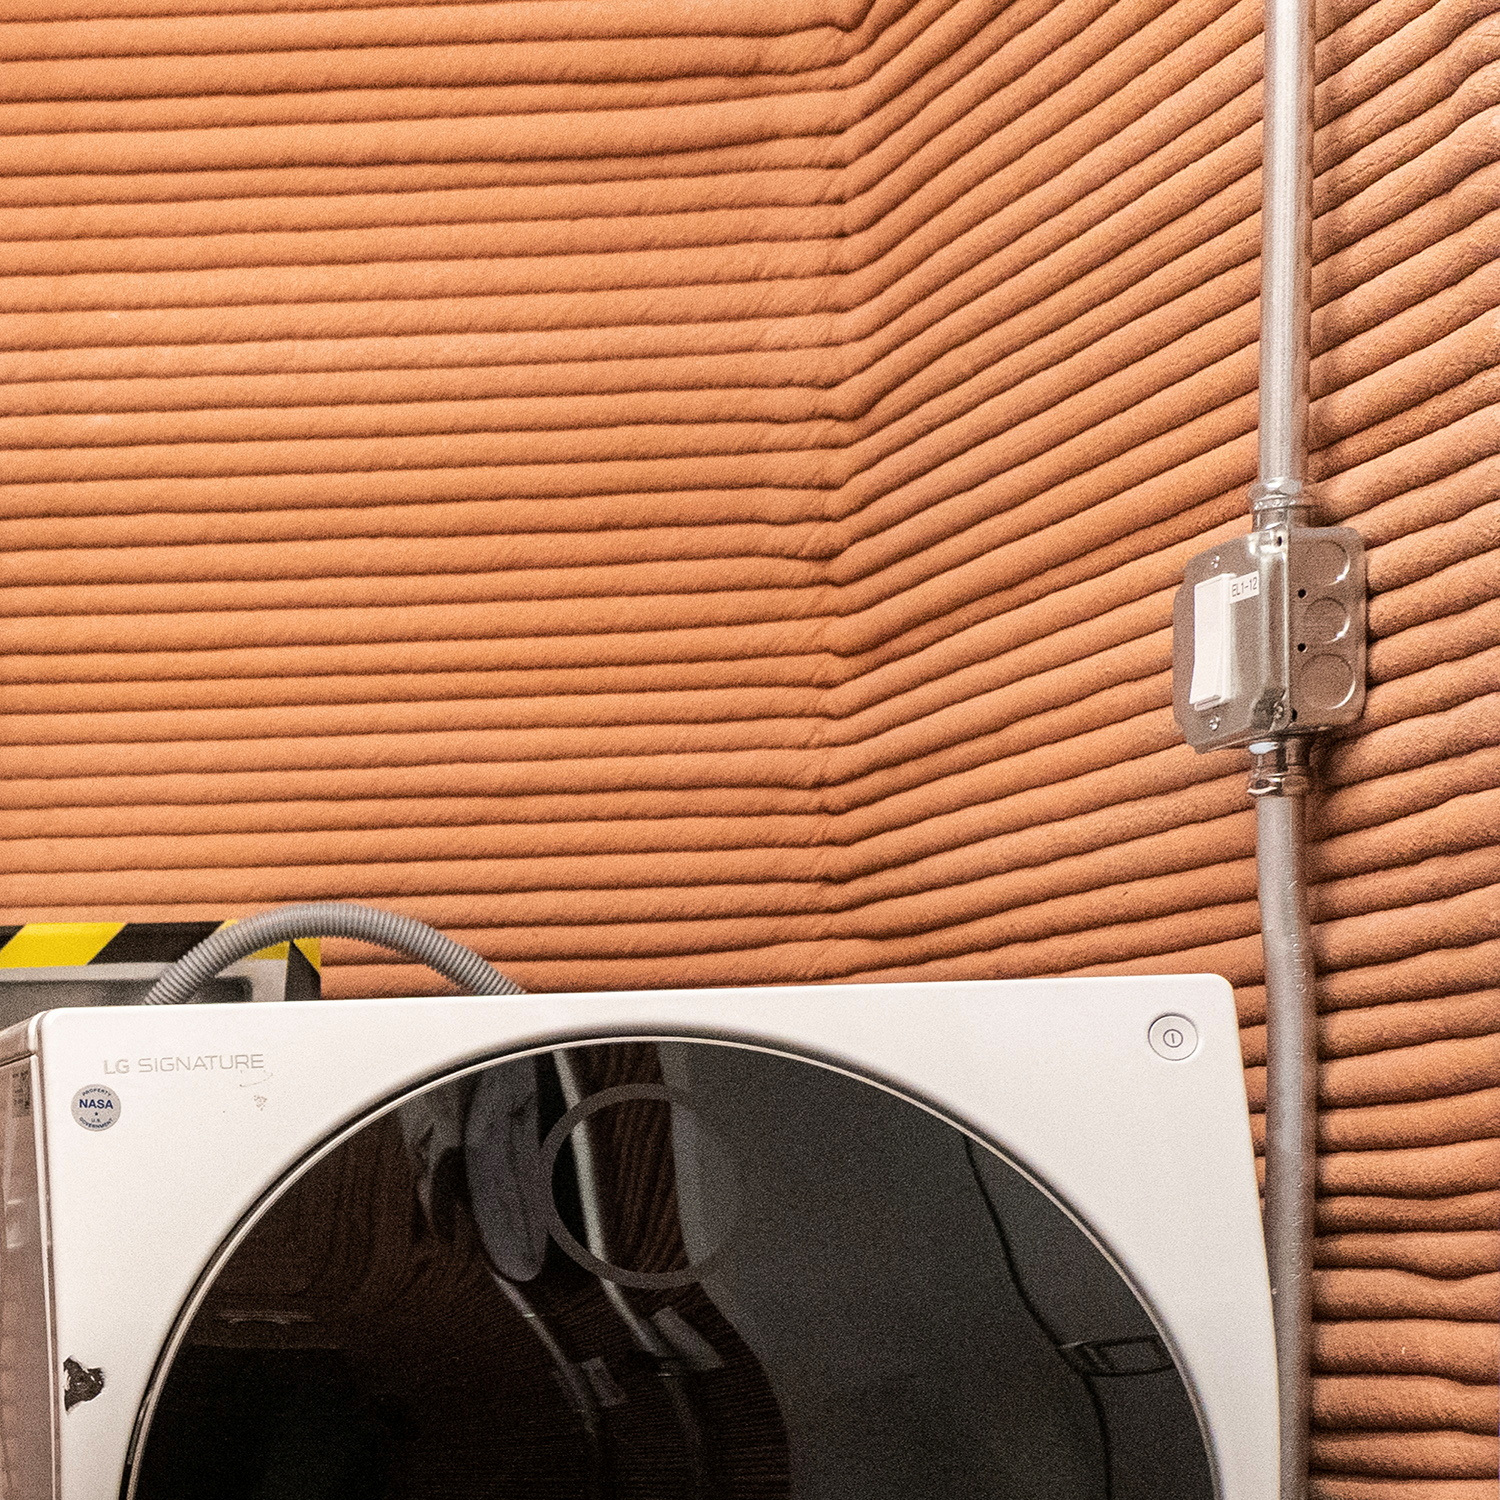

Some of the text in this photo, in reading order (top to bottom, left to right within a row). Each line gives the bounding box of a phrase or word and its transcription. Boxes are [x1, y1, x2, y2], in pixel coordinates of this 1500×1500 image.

[1232, 576, 1257, 597] EL1-12
[103, 1053, 264, 1075] LG SIGNATURE
[79, 1099, 114, 1109] NASA
